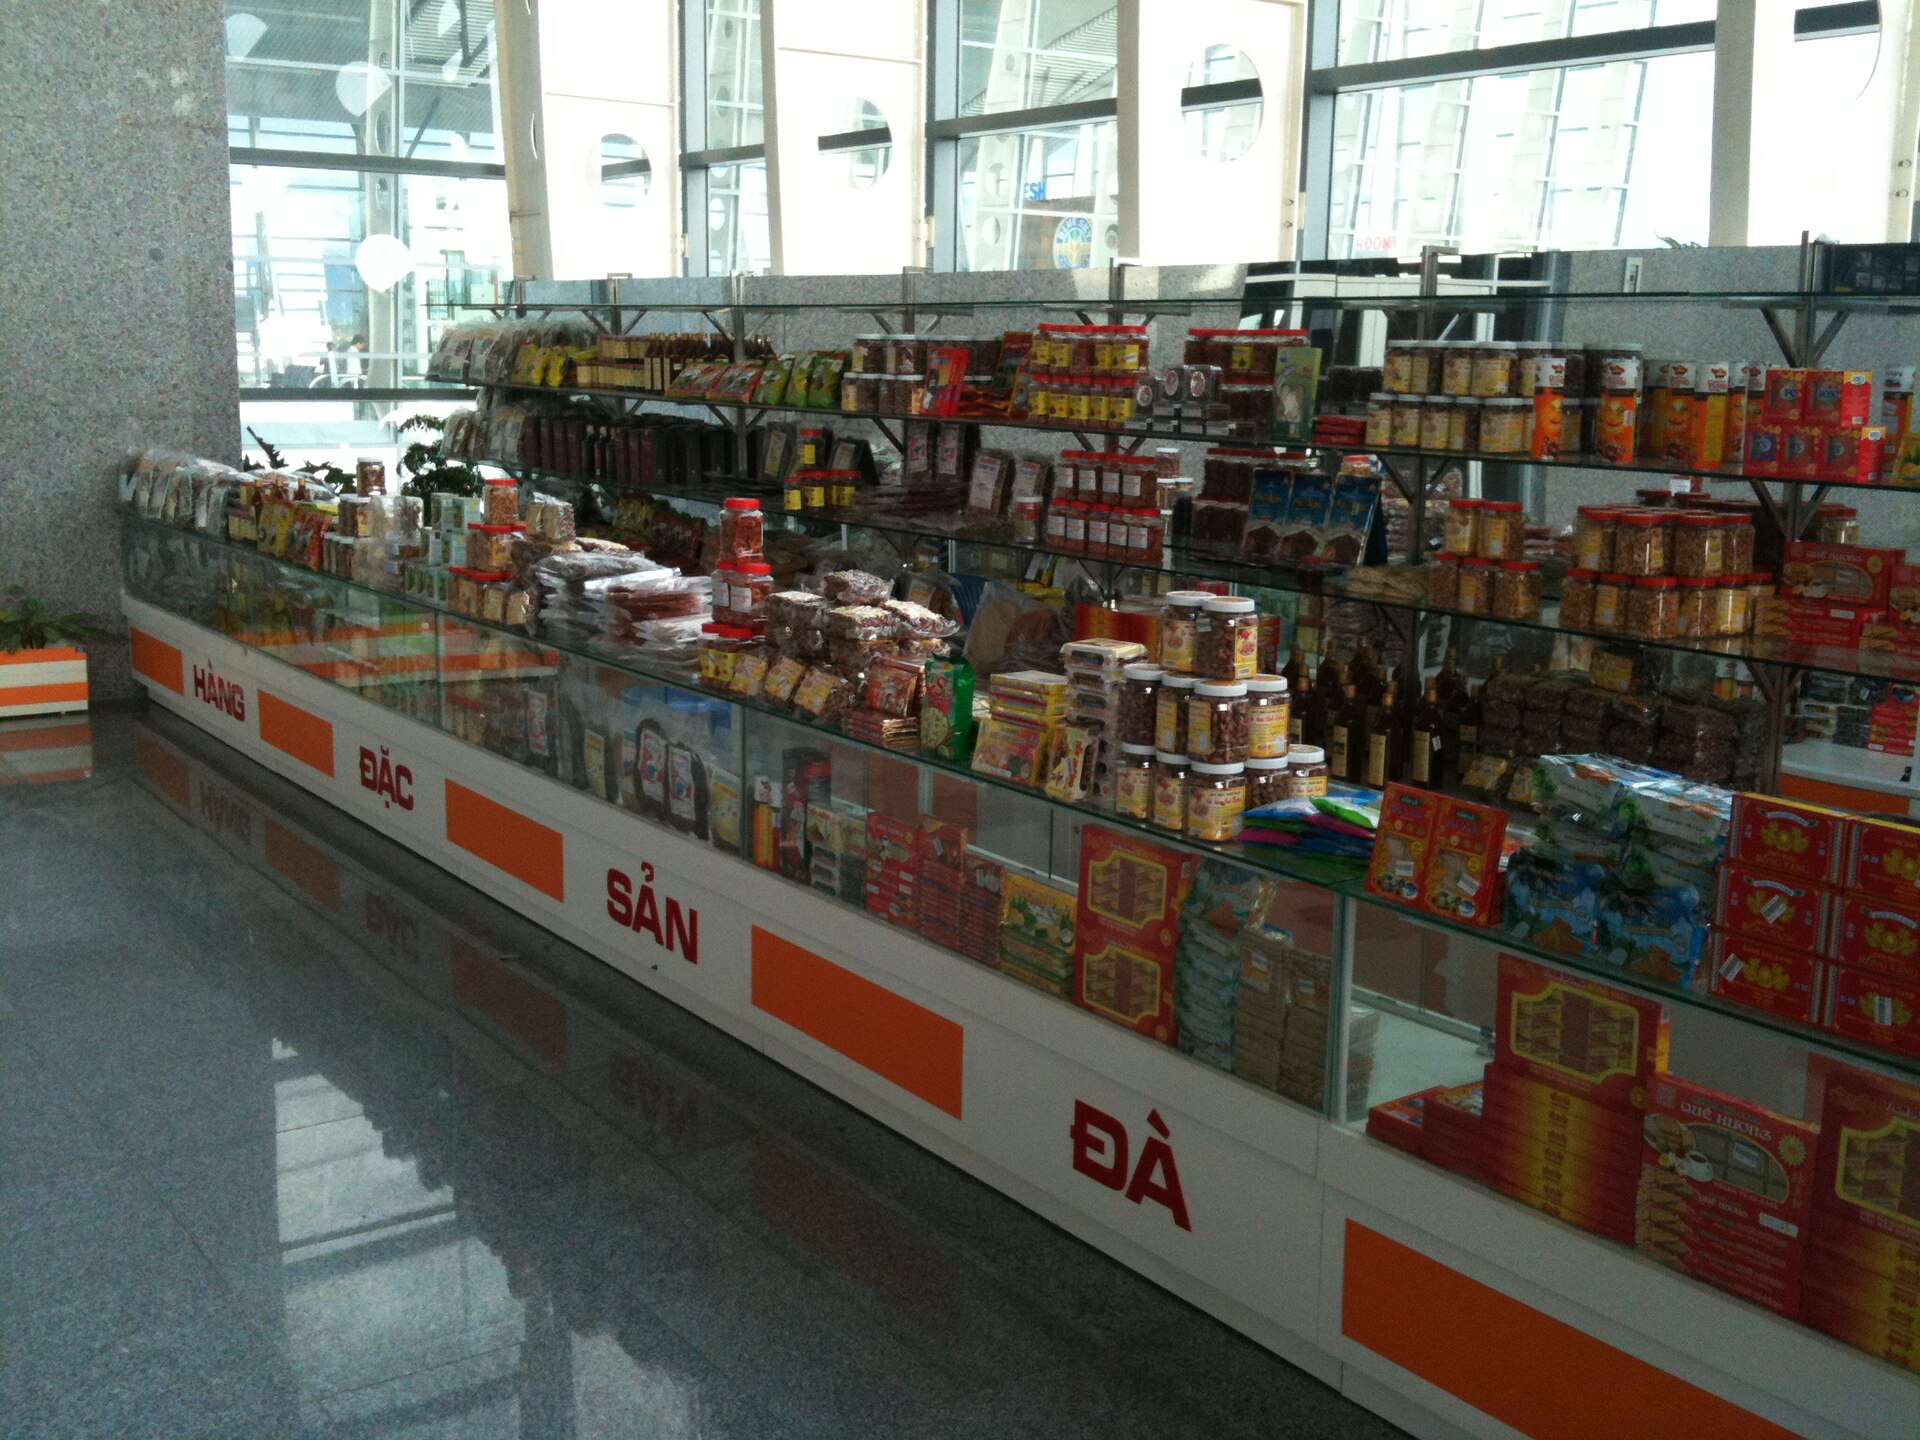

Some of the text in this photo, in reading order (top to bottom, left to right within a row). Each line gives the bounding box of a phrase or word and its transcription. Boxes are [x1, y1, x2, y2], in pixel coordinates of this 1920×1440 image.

[193, 659, 1193, 1232] HÀNG ĐẶC SẢN ĐÀ
